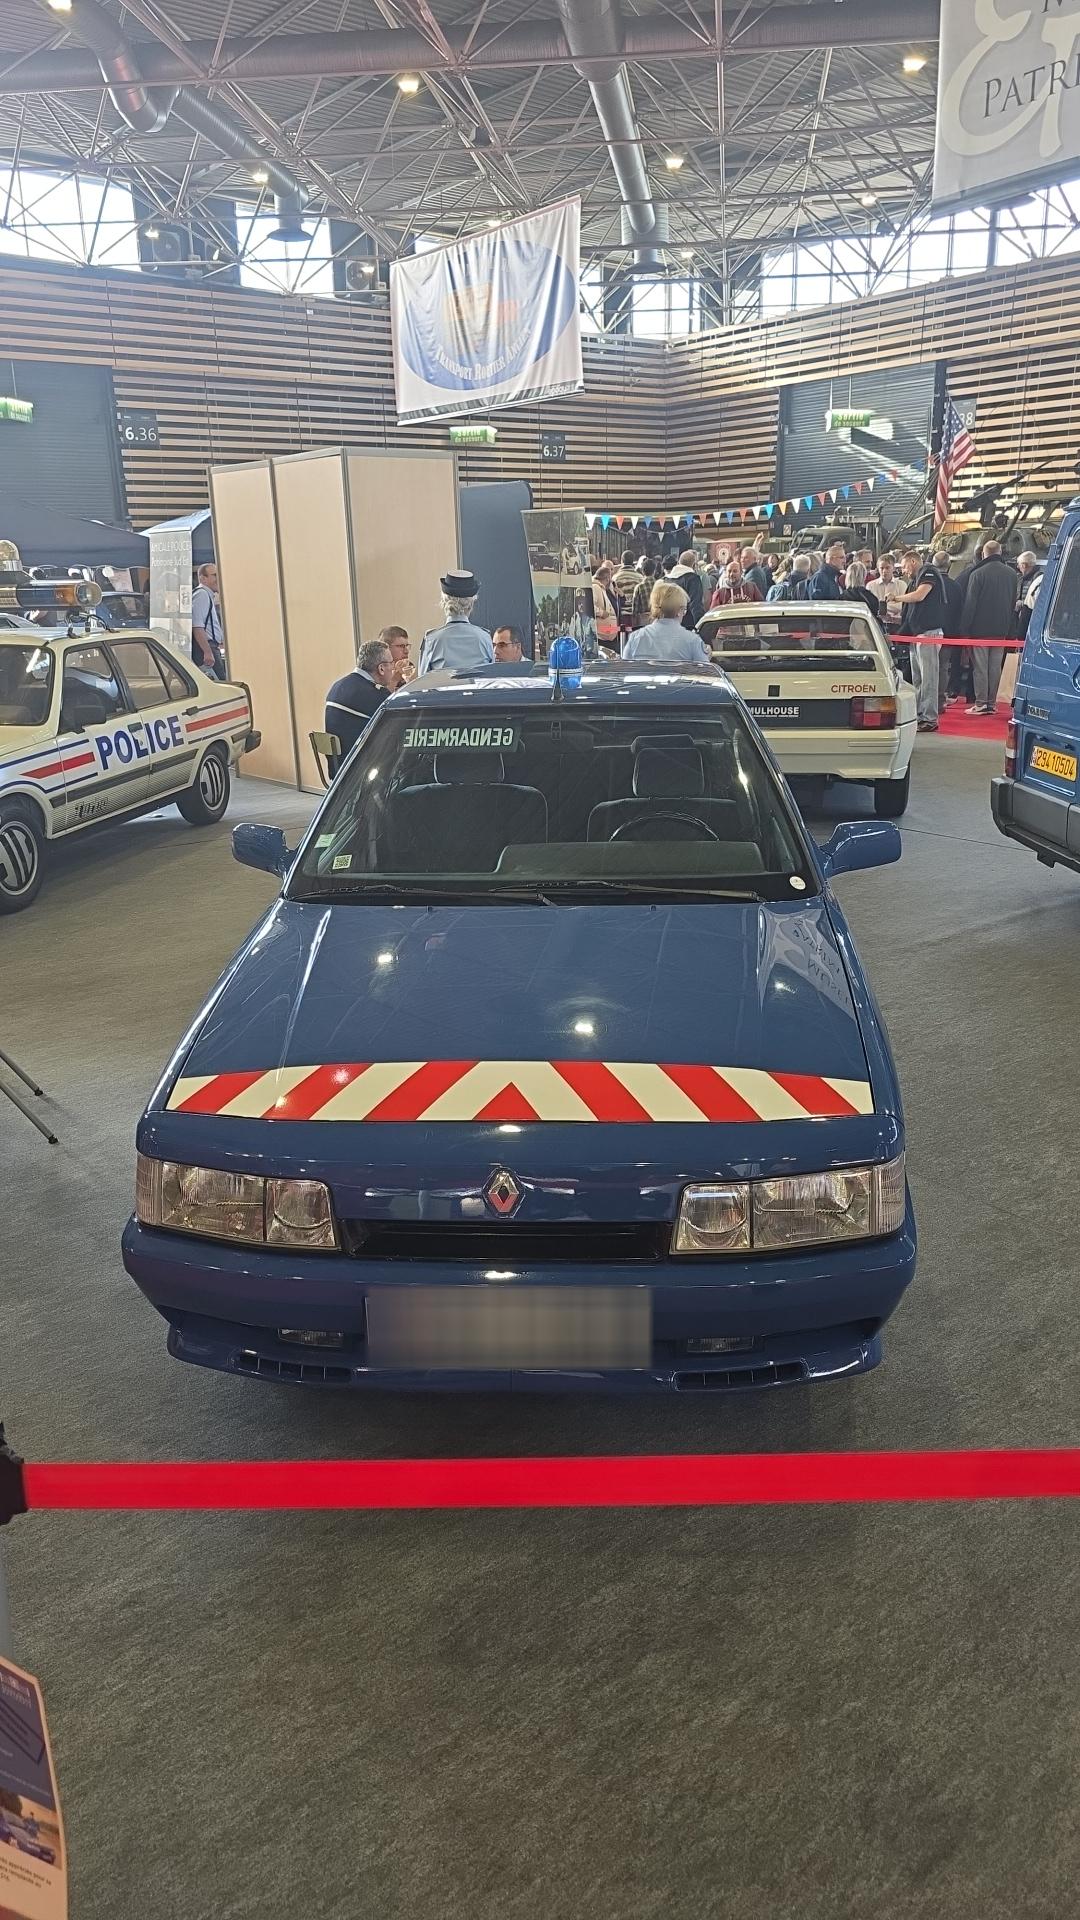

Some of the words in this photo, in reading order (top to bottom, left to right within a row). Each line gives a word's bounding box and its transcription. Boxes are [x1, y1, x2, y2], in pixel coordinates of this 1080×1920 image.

[125, 426, 157, 441] 6.36
[543, 445, 564, 457] 6.37
[95, 715, 184, 770] POLICE
